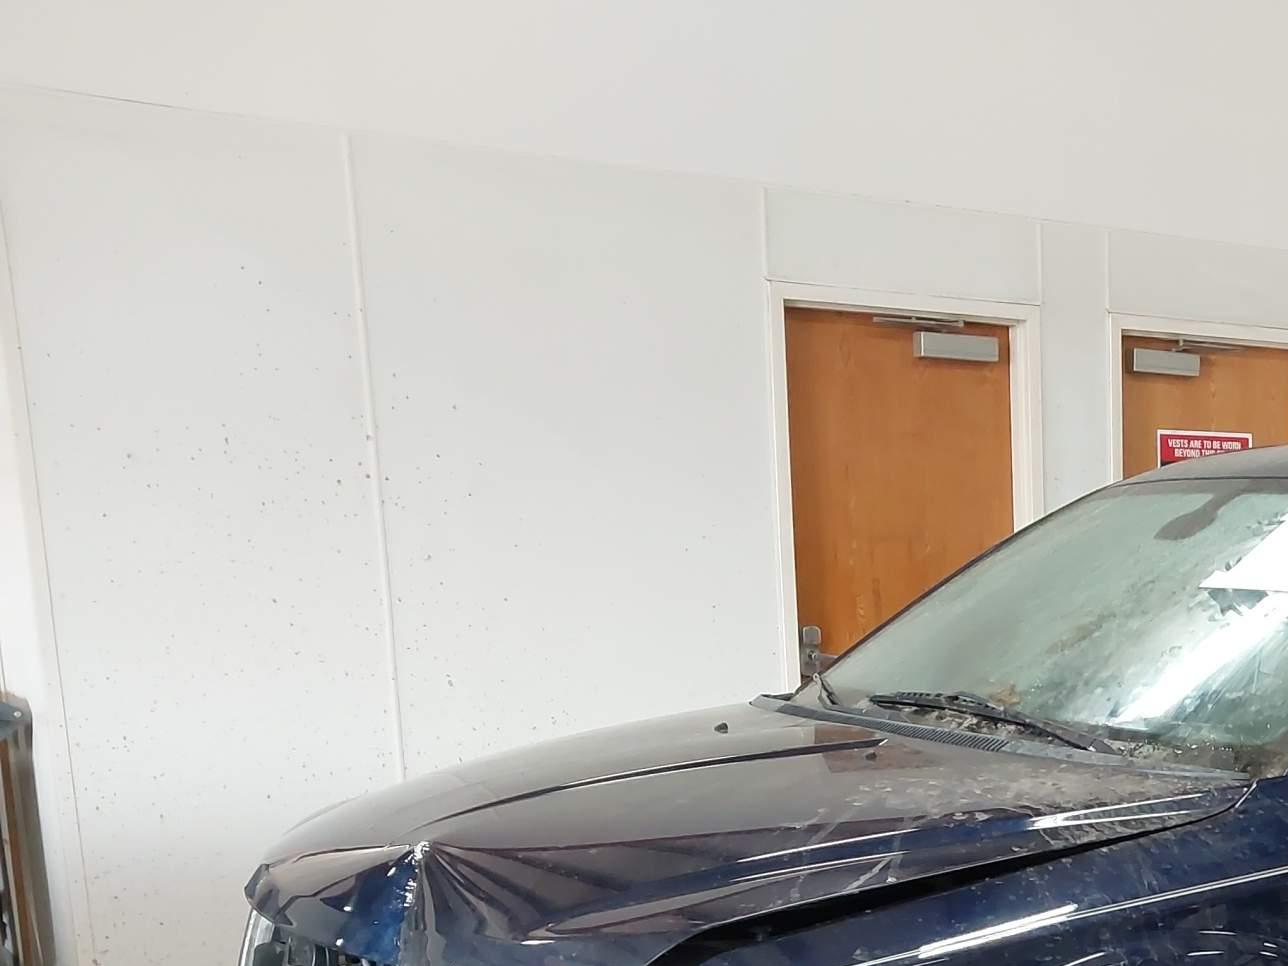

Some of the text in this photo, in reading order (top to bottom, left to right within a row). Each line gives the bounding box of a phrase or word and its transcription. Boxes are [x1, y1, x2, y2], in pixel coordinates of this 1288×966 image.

[1168, 438, 1241, 450] VESTS ARE TO BE WORN
[1174, 448, 1201, 458] BEYOND
